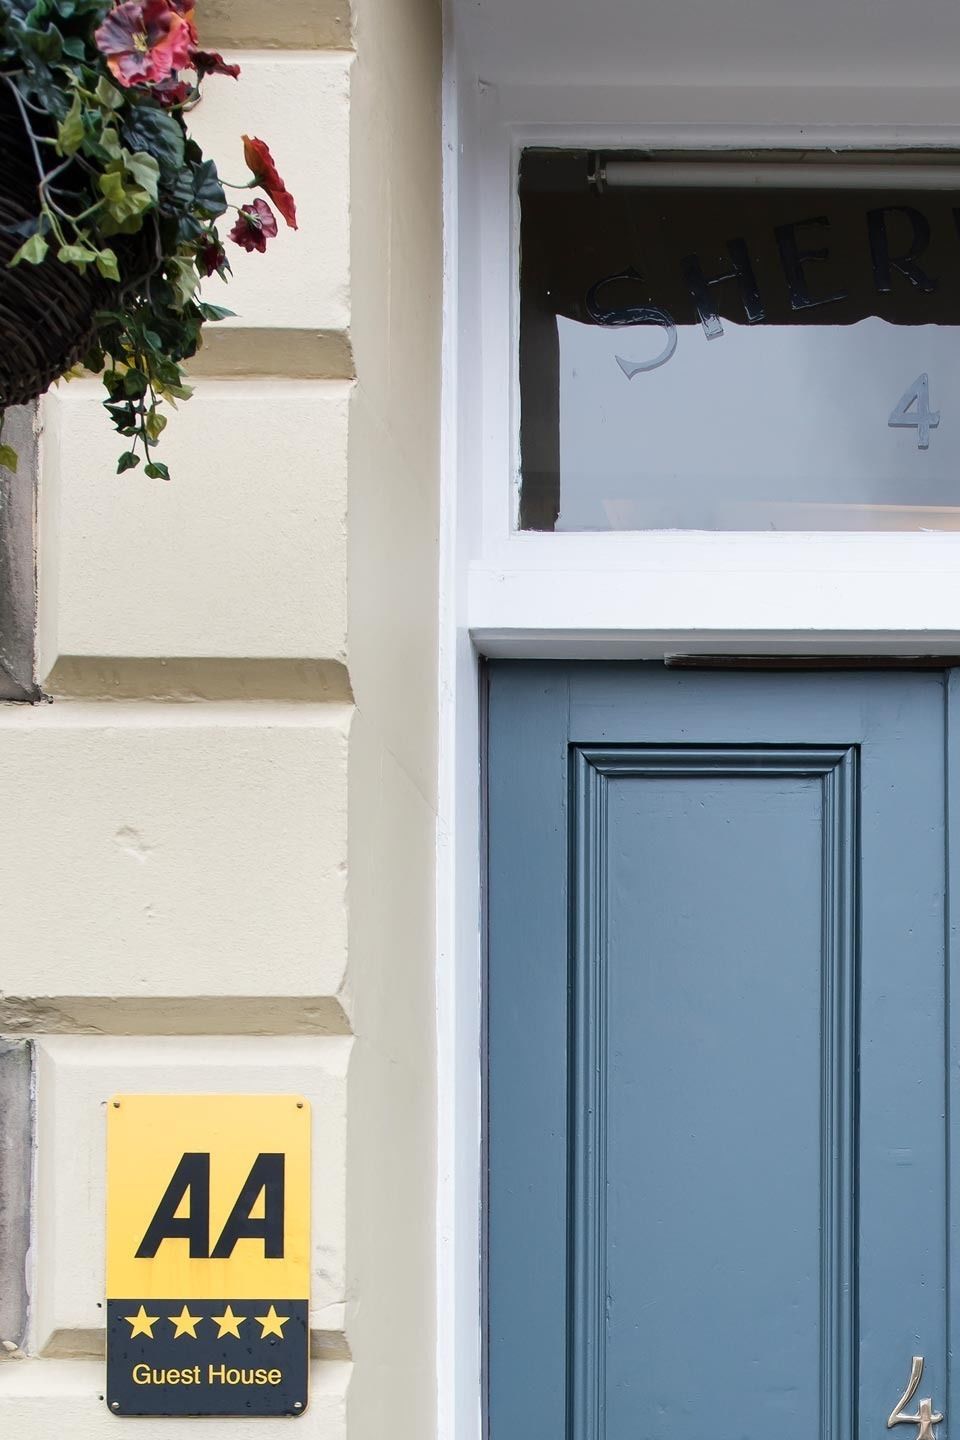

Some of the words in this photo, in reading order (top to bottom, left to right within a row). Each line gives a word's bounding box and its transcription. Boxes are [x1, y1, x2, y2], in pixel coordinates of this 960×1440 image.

[134, 1152, 285, 1259] AA
[132, 1364, 201, 1385] Guest
[208, 1364, 282, 1385] House
